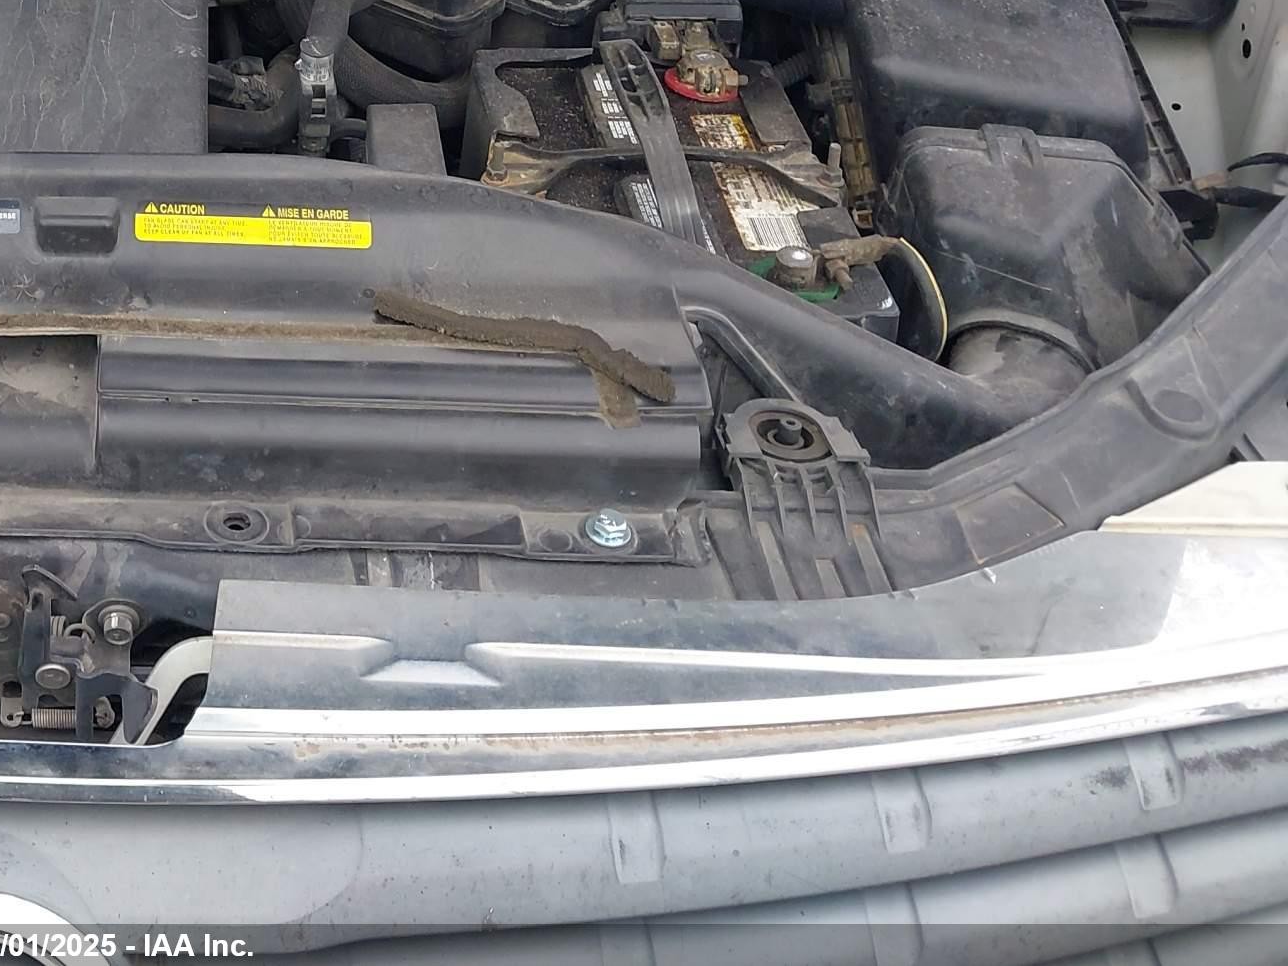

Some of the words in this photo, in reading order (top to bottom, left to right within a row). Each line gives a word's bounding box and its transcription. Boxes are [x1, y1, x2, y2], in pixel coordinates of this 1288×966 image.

[159, 204, 205, 215] CAUTION
[277, 207, 300, 218] MISE
[301, 208, 315, 219] EN
[316, 209, 350, 220] GARDE
